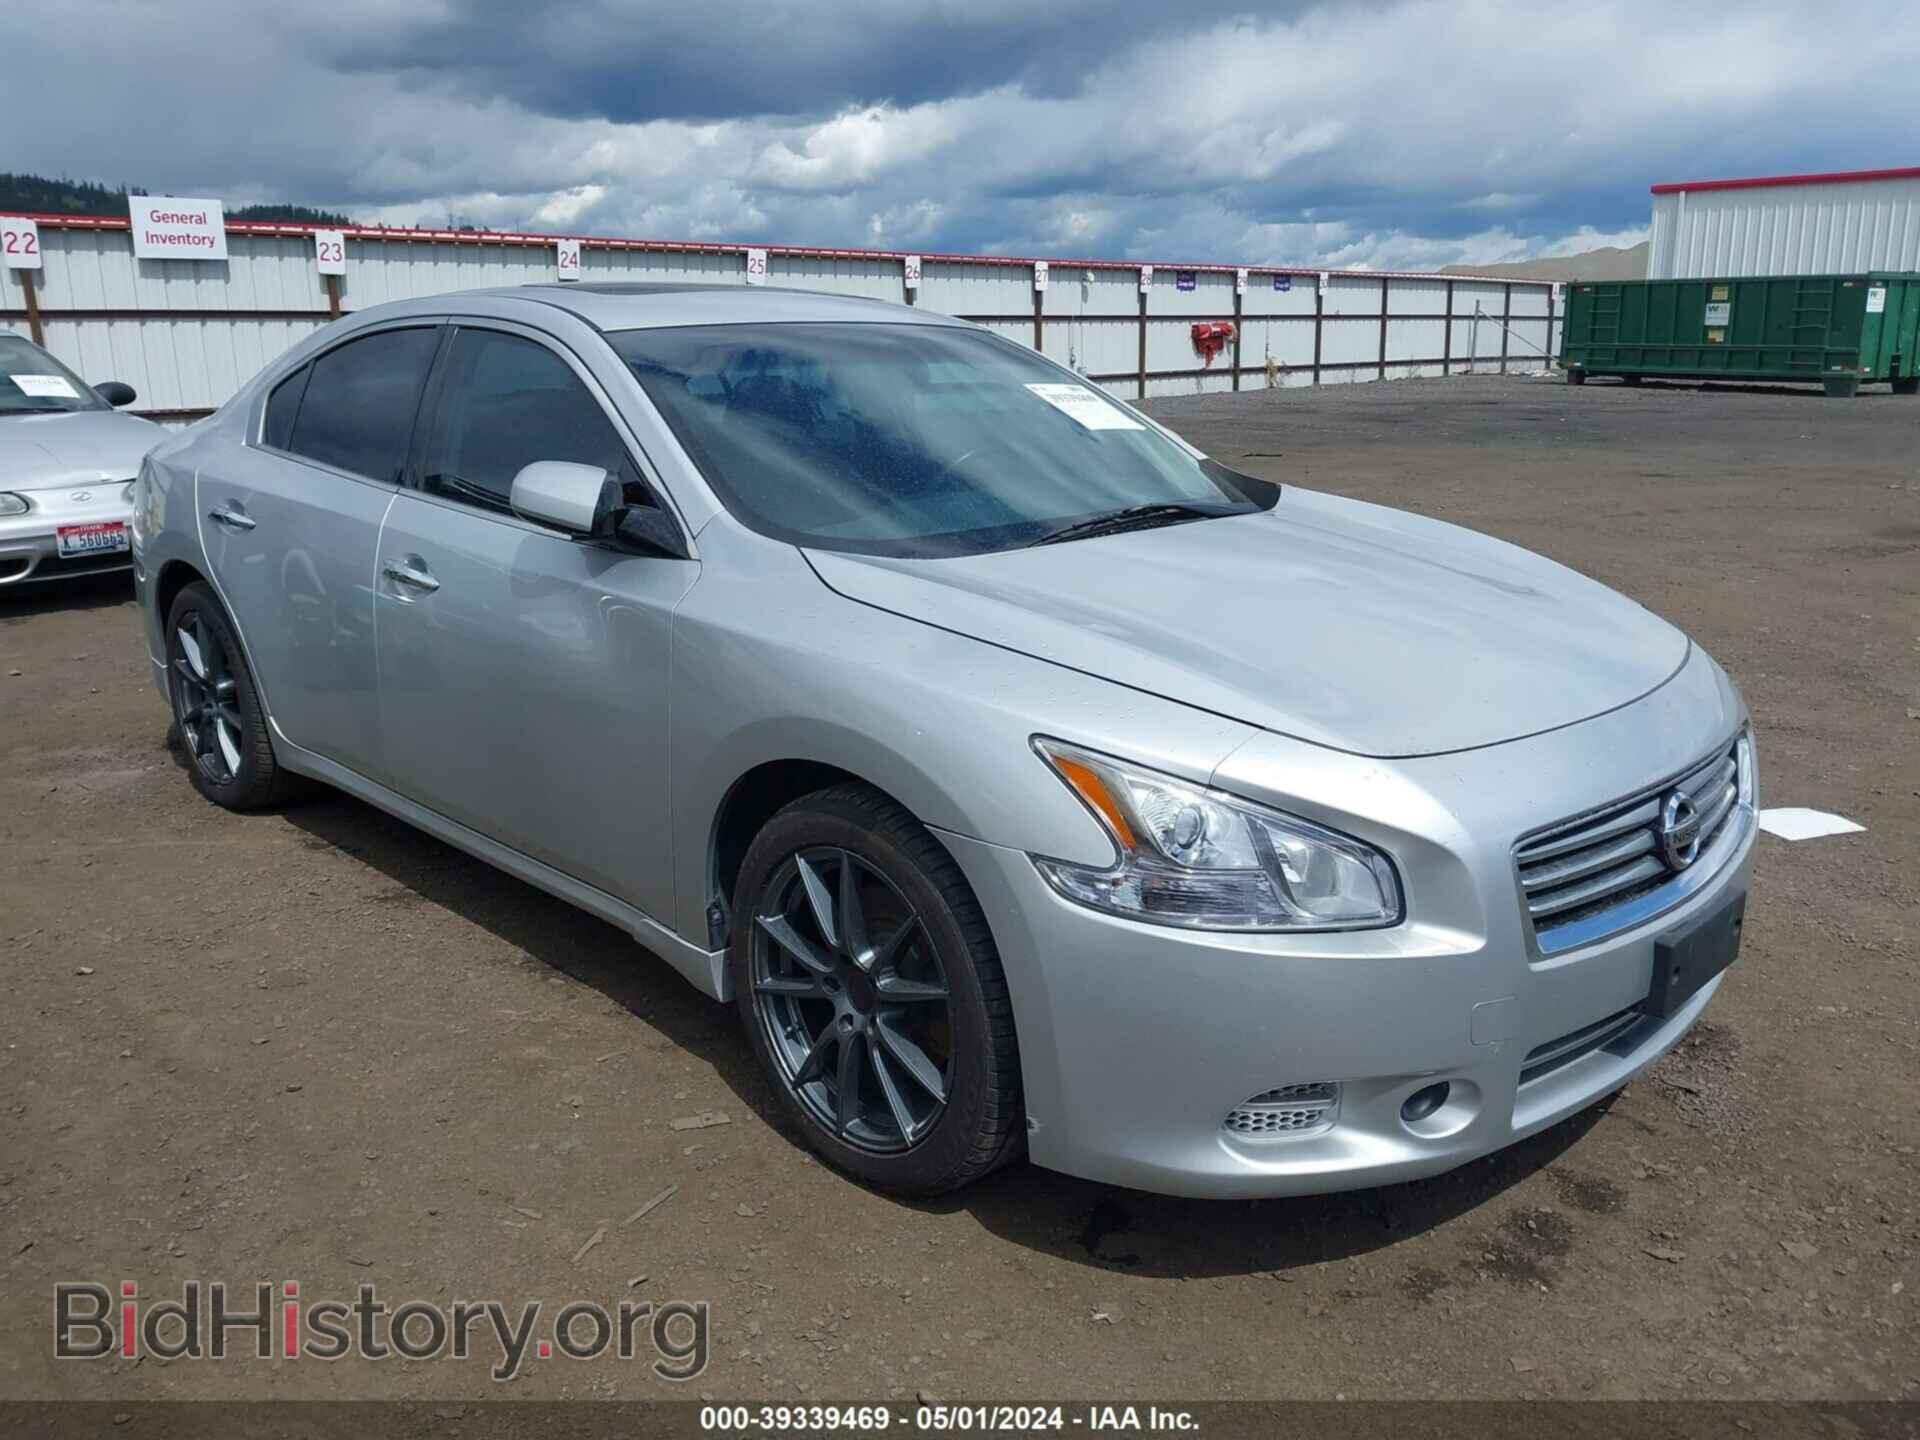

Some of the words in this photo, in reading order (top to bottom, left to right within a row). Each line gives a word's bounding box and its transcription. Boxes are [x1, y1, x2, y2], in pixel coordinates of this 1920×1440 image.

[150, 209, 207, 225] General
[4, 231, 38, 254] 22
[145, 230, 215, 248] Inventory
[319, 242, 342, 262] 23
[560, 250, 577, 268] 24
[750, 258, 764, 274] 25
[905, 265, 919, 280] 26
[1035, 269, 1048, 283] 27
